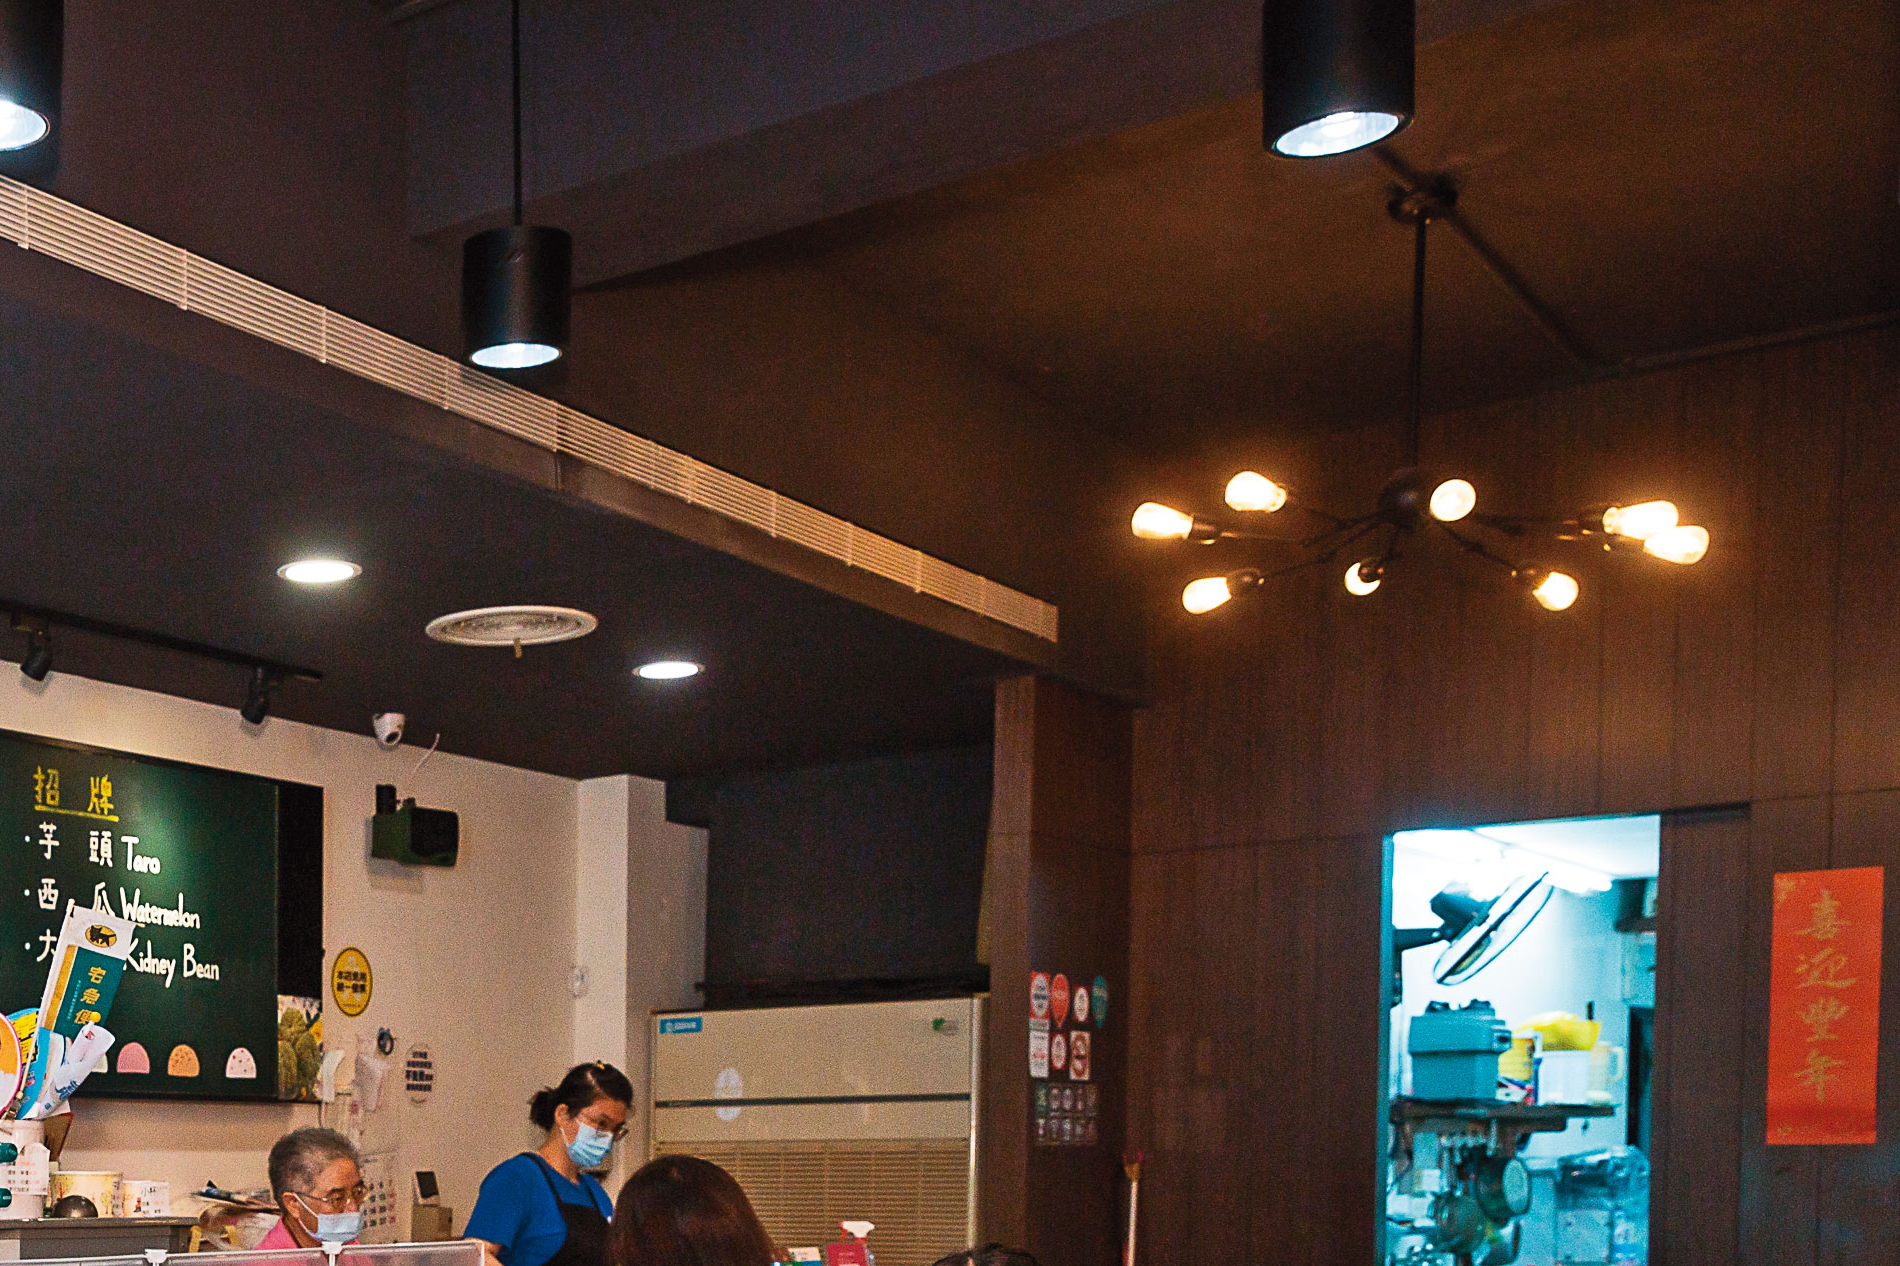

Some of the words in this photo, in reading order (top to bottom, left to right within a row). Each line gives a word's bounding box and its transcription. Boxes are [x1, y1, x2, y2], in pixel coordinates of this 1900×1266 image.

[120, 836, 161, 874] Taro
[119, 886, 201, 929] Watermelon
[182, 943, 220, 981] Bean
